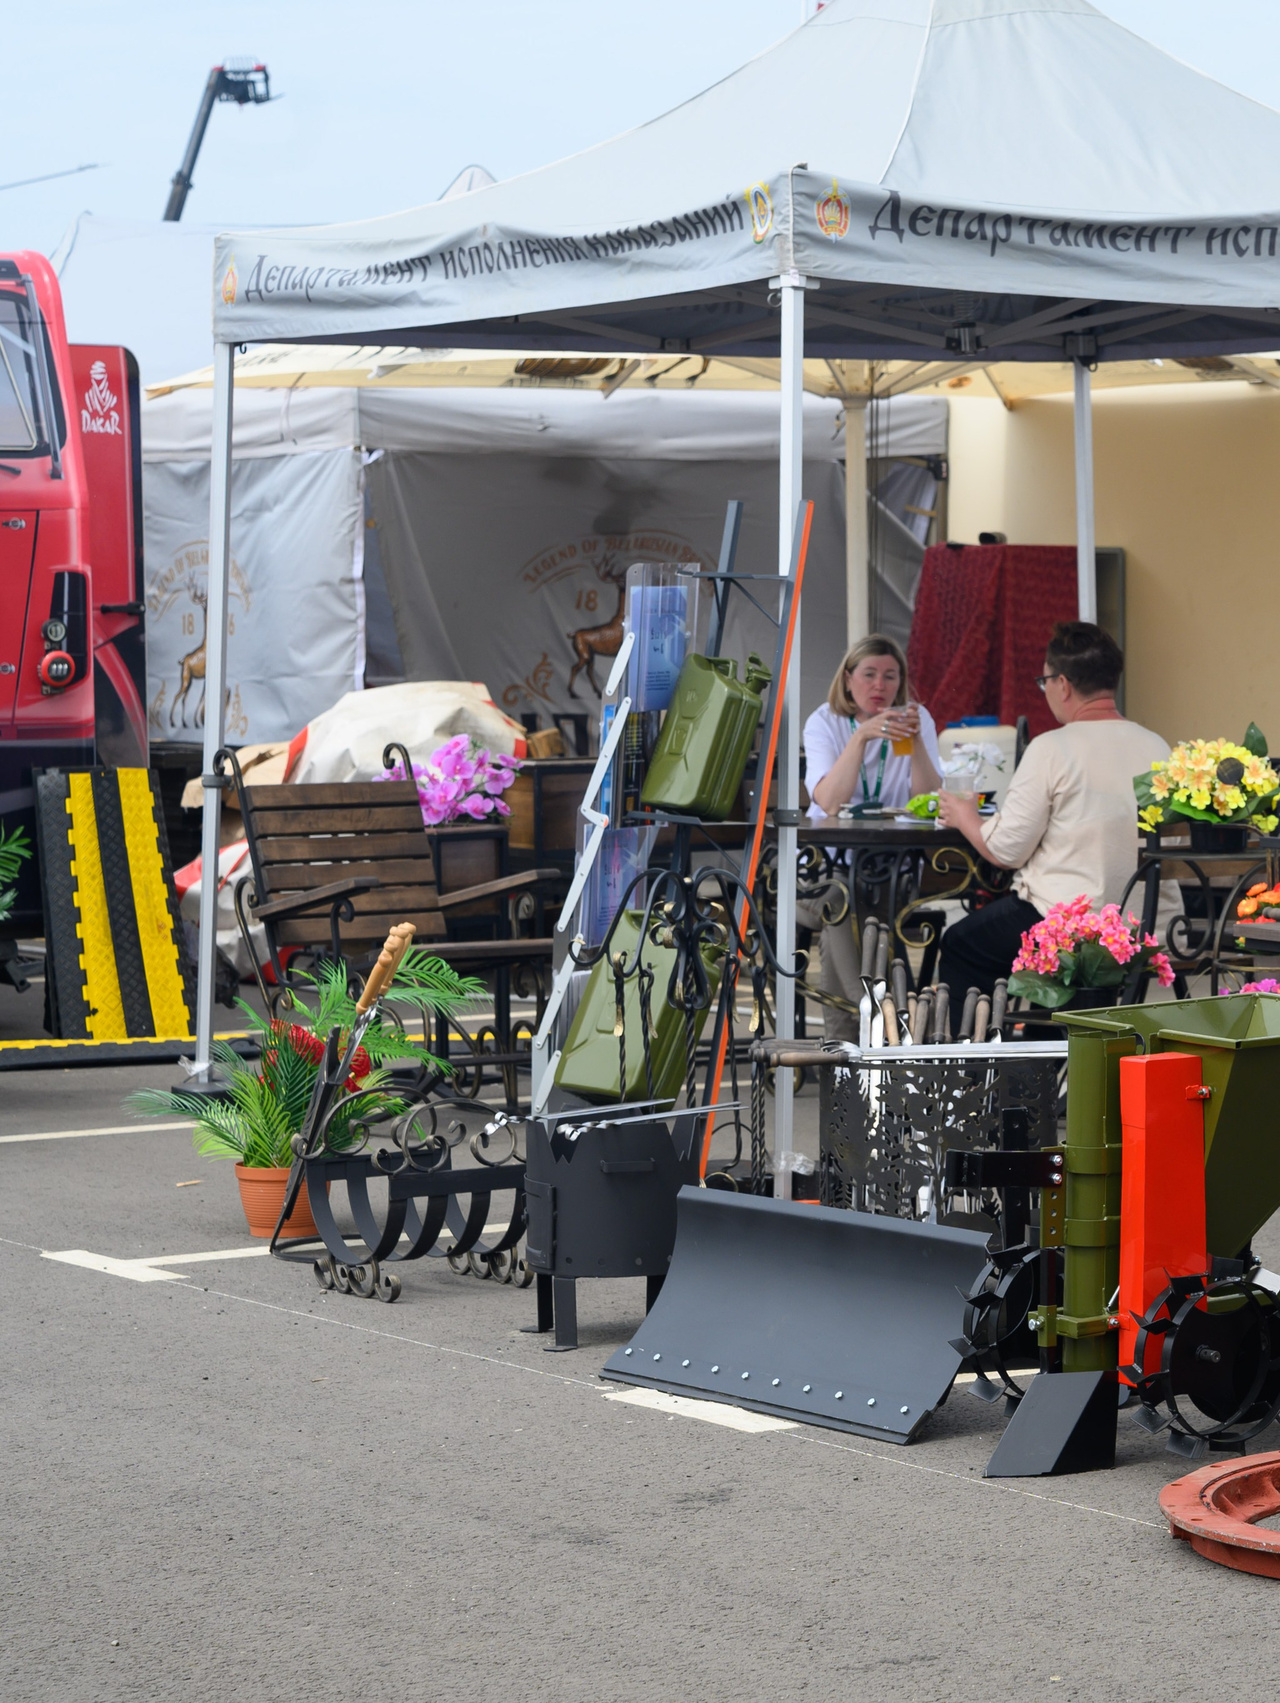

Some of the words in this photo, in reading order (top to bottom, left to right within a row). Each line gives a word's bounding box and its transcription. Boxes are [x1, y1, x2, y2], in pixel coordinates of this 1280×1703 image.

[867, 189, 1196, 260] Департамент
[245, 254, 432, 302] Департамент
[439, 236, 589, 280] исполнения
[582, 192, 745, 259] наказаний
[81, 408, 122, 435] DAKAR
[575, 589, 599, 611] 18
[182, 613, 195, 635] 18
